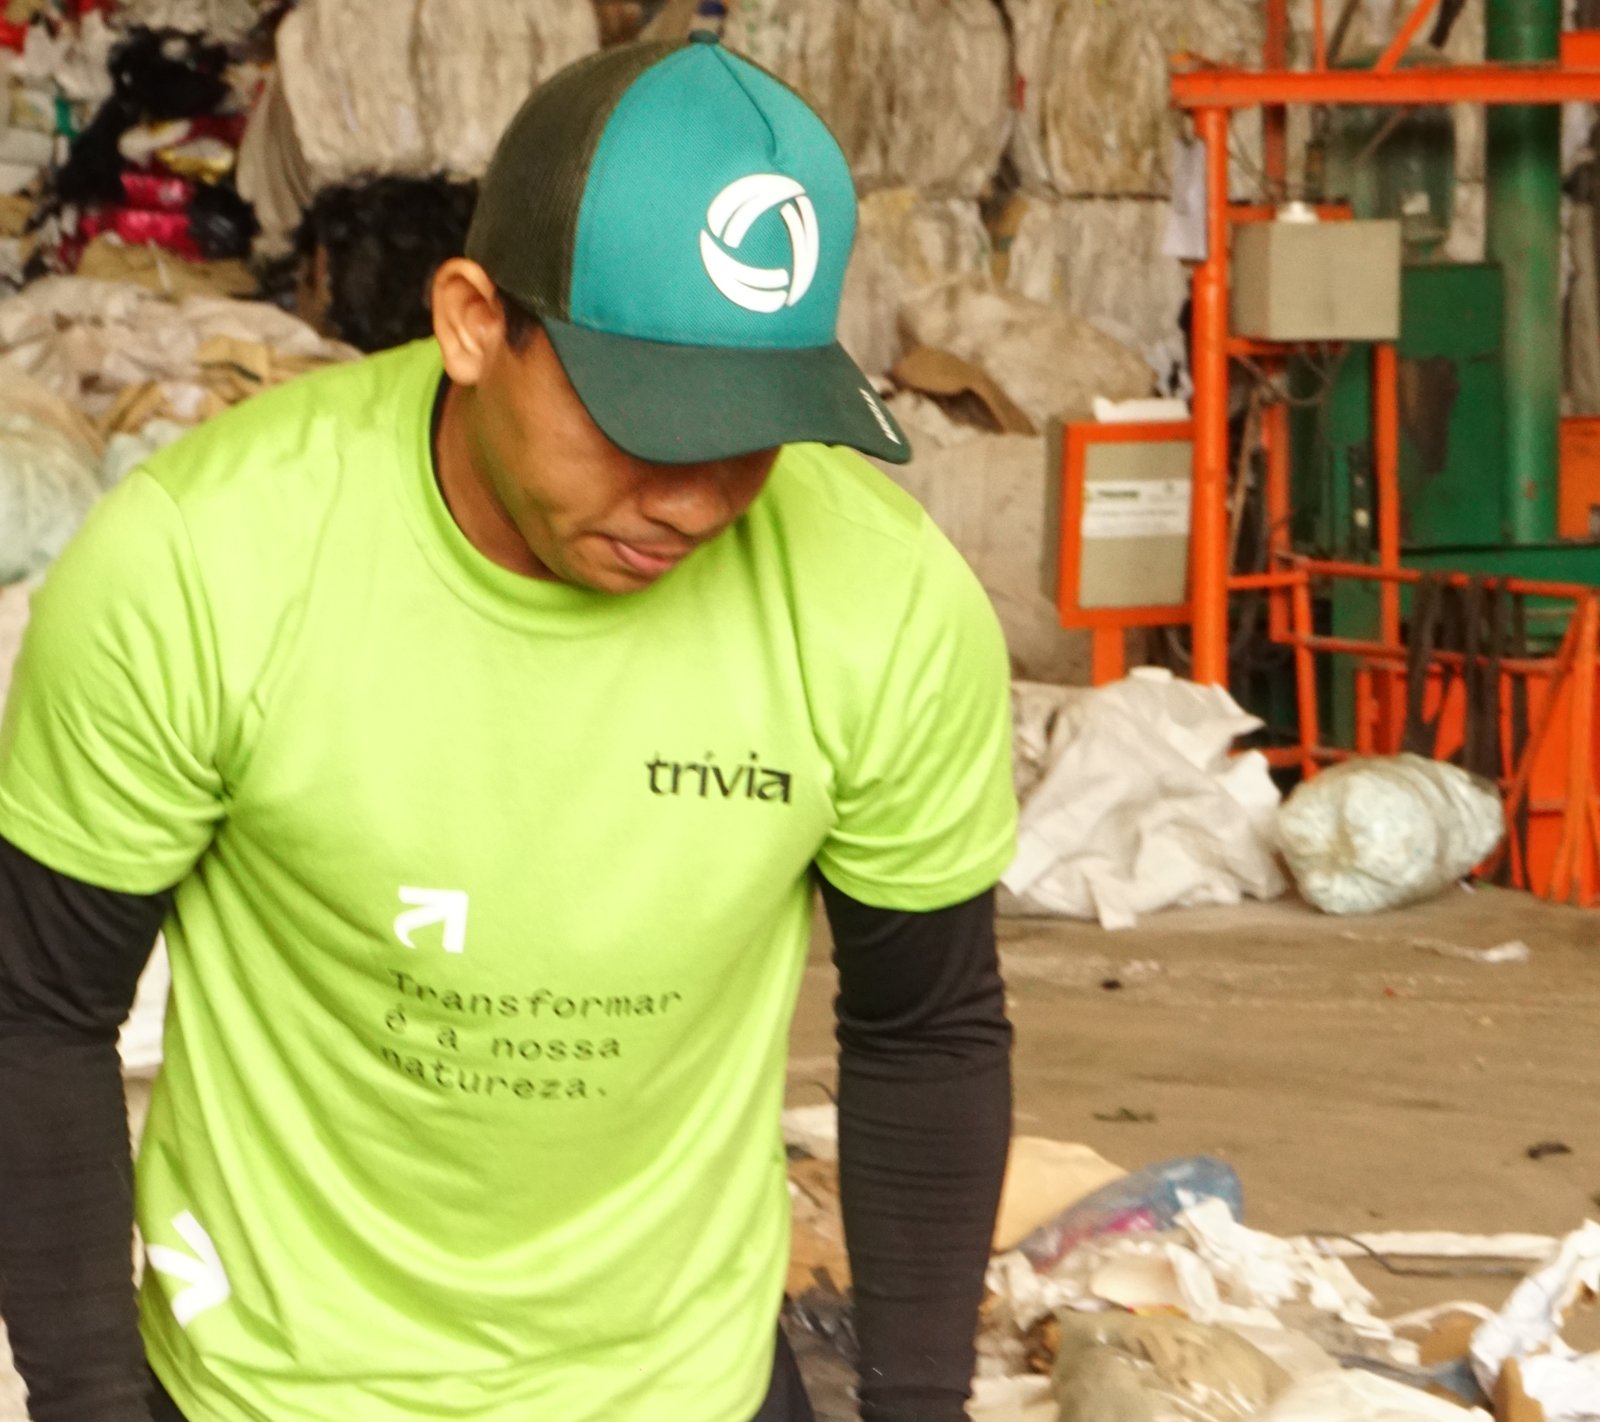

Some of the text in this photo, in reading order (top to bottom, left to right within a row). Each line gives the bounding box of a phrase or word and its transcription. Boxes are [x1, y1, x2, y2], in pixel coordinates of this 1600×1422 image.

[386, 967, 682, 1019] Transformar
[436, 1026, 458, 1052] a
[491, 1036, 621, 1062] nossa
[381, 1046, 608, 1100] natureza.
